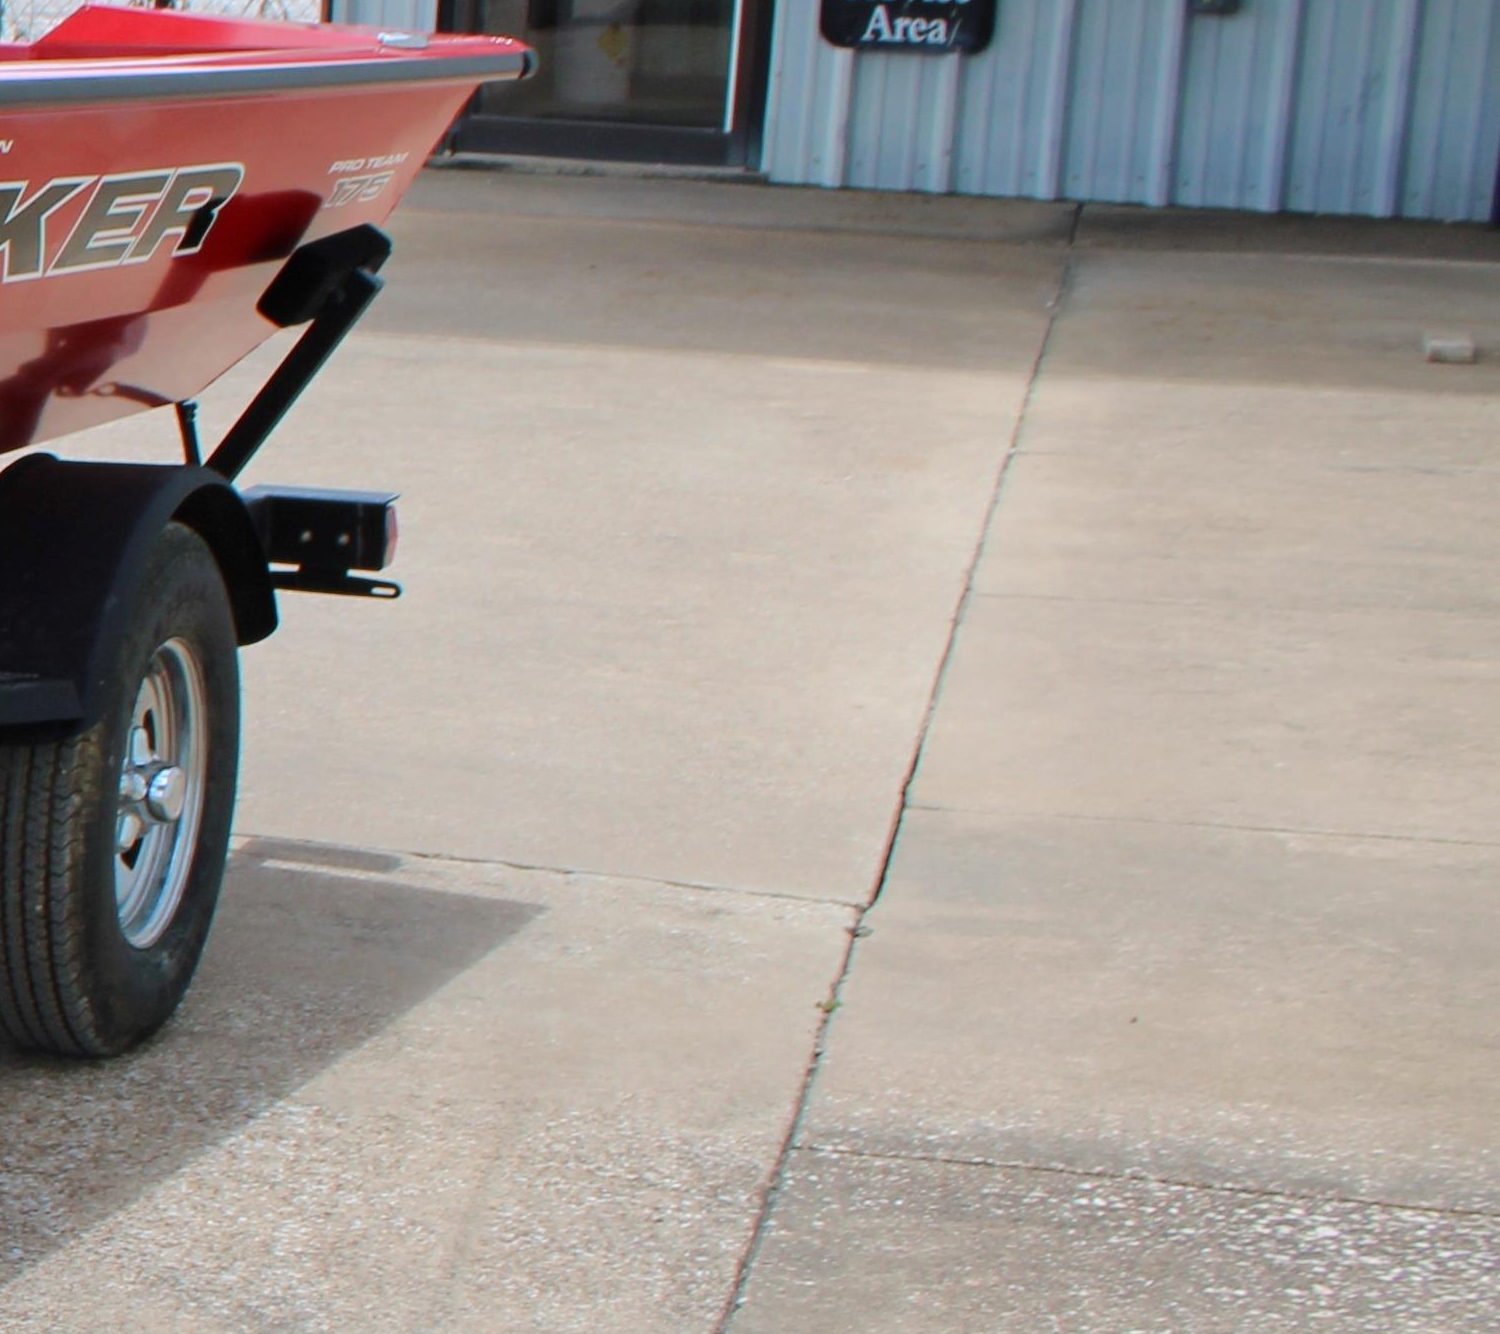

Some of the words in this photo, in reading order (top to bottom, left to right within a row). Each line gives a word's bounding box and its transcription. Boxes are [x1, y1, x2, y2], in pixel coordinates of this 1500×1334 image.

[861, 5, 948, 44] Area
[326, 159, 366, 175] PRO
[366, 152, 410, 169] TEAM
[323, 170, 396, 209] 175
